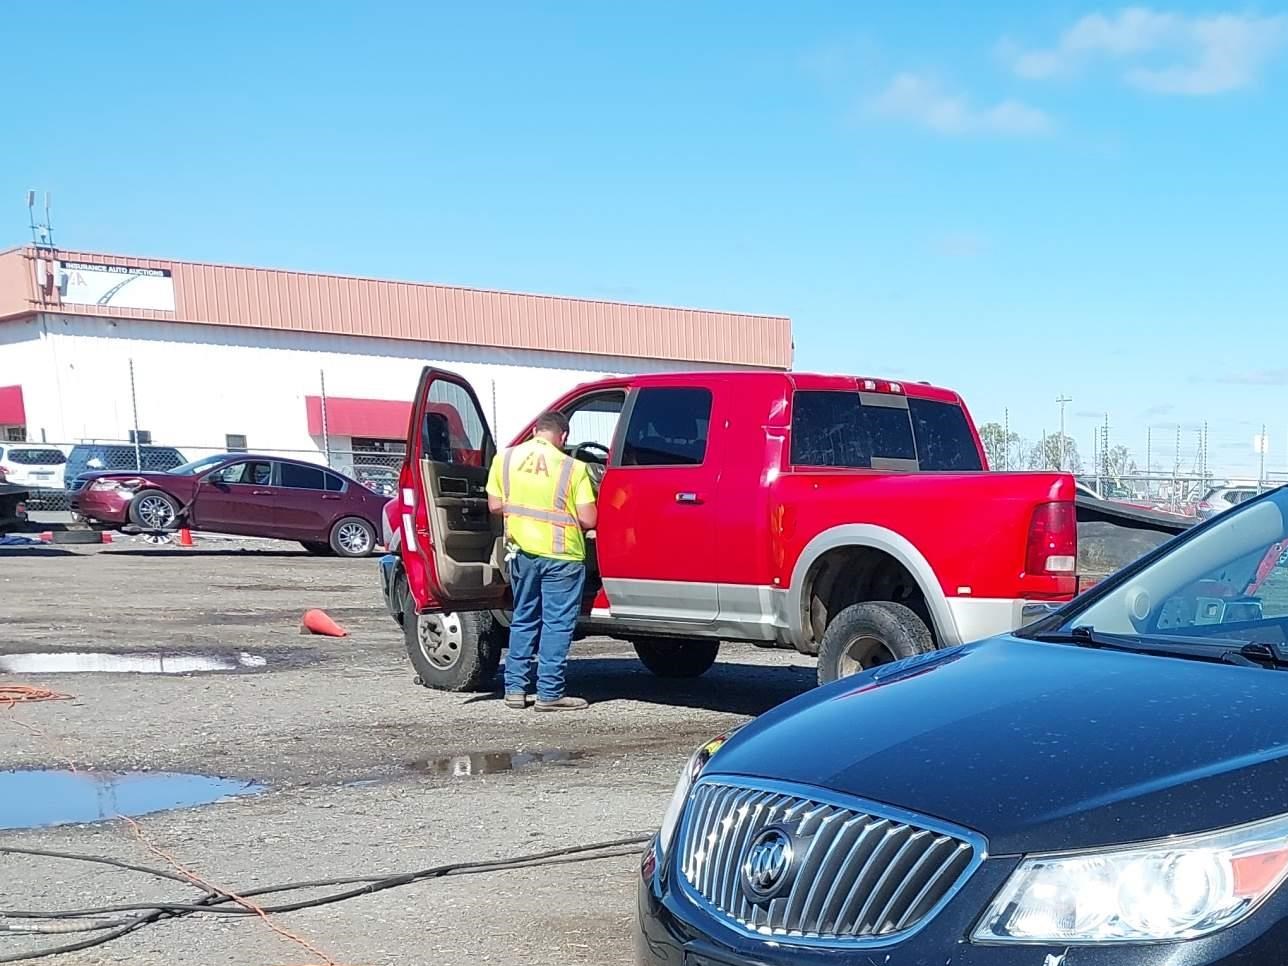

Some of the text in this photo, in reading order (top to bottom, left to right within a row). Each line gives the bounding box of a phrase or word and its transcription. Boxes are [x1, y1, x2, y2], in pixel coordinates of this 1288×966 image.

[65, 262, 164, 277] INSURANCE AUTO AUCTIONS
